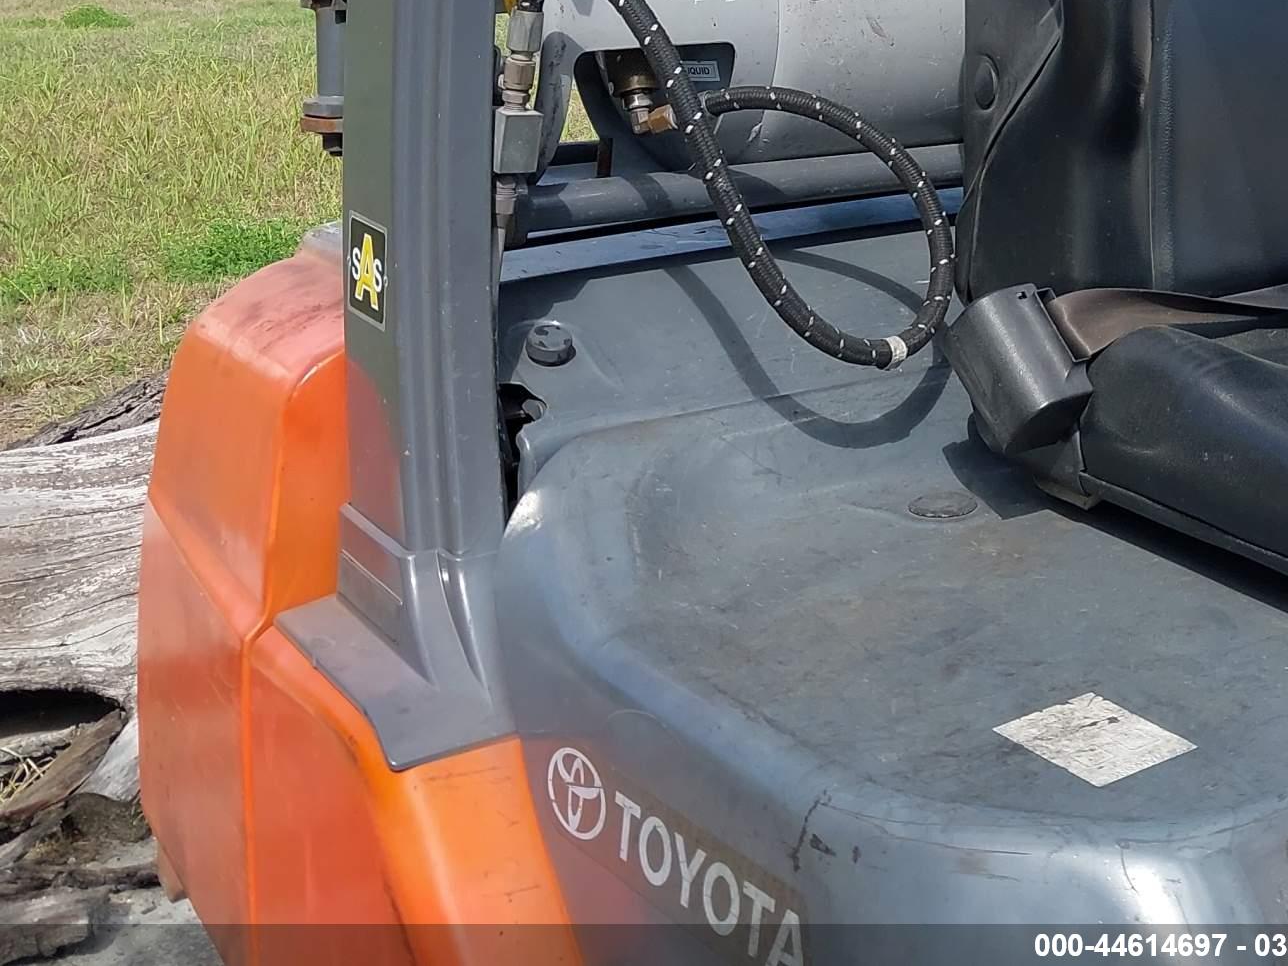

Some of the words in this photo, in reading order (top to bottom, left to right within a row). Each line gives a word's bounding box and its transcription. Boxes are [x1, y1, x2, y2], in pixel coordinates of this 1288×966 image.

[687, 66, 710, 75] IQUID
[351, 233, 383, 311] SAS
[615, 791, 804, 966] TOYOTA
